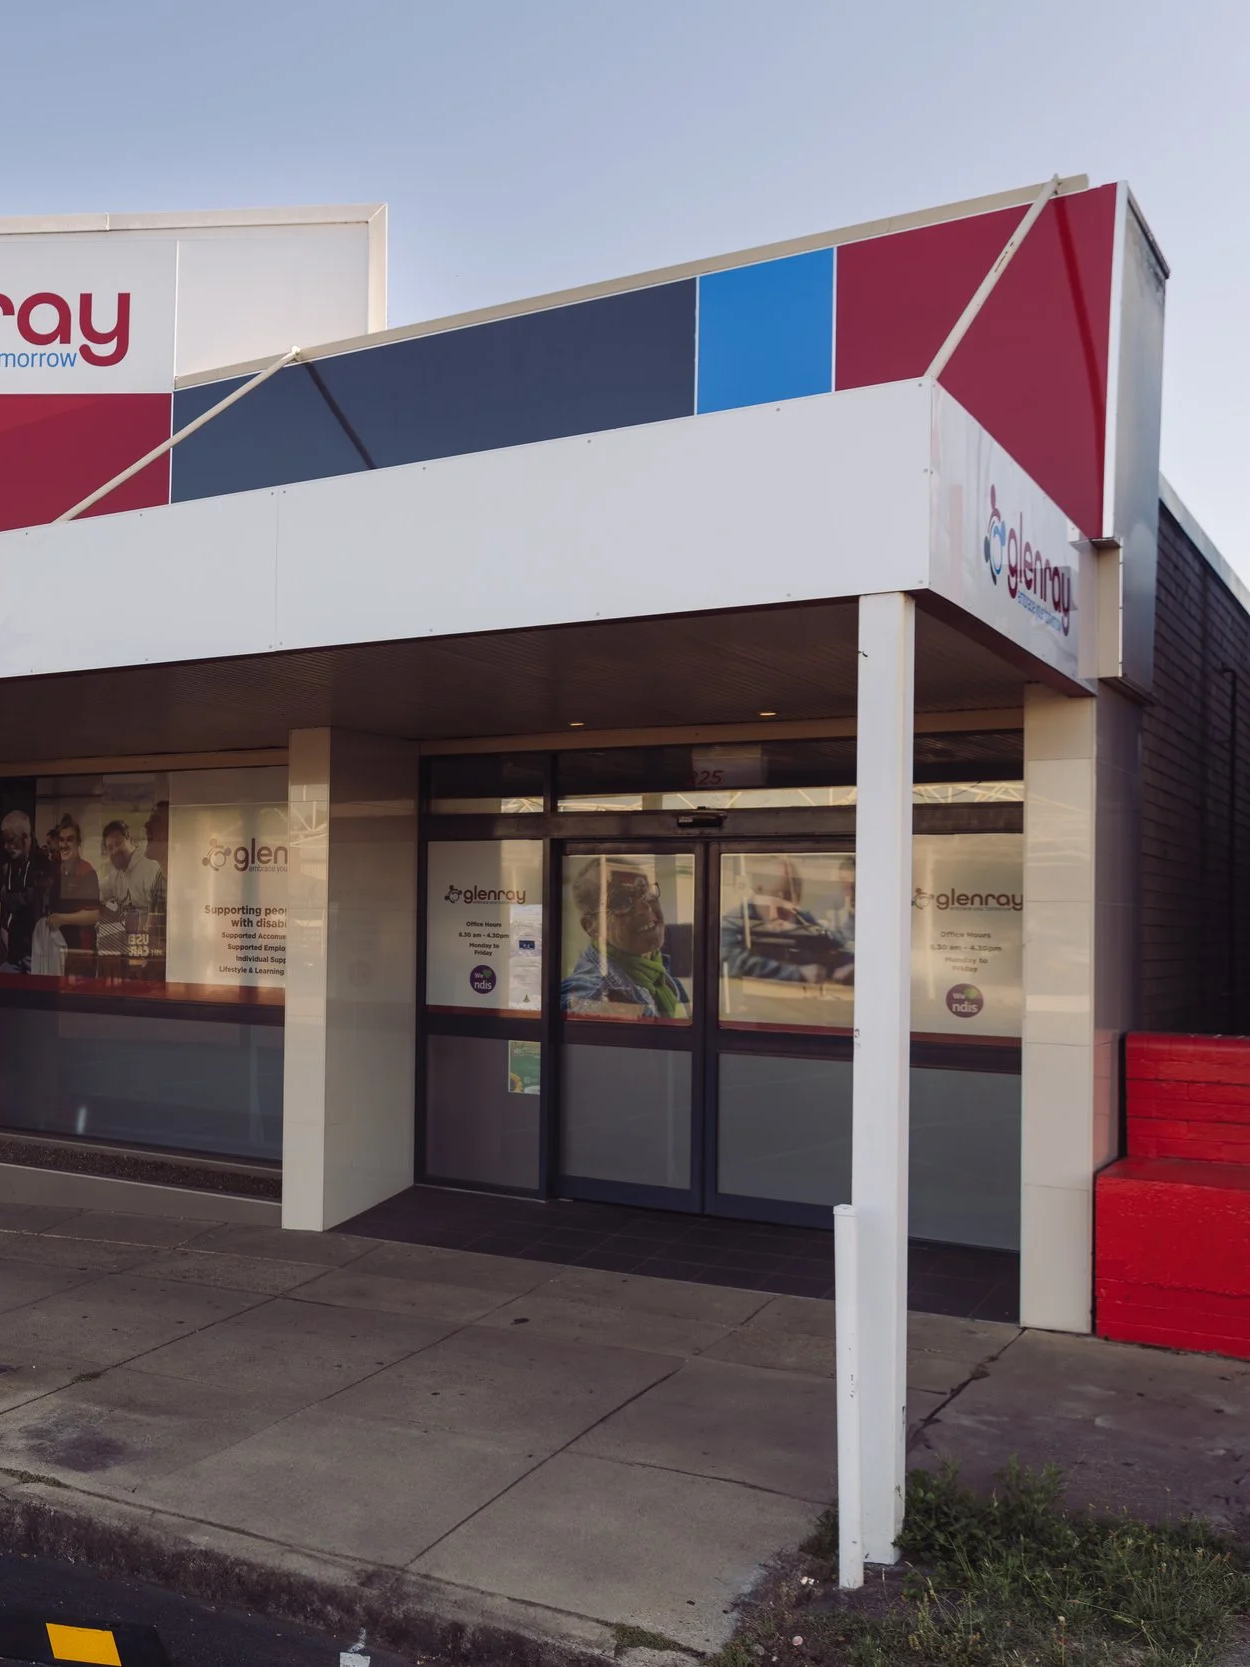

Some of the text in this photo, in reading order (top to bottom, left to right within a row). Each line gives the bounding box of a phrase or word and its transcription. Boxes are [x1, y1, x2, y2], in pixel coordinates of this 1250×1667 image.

[1007, 511, 1071, 637] glenray
[233, 837, 288, 872] glen
[249, 865, 288, 874] embrace you
[463, 885, 526, 905] glenray
[936, 888, 1023, 911] glenray
[204, 905, 262, 917] Supporting
[231, 917, 253, 928] with
[221, 932, 257, 940] Supported
[966, 931, 991, 939] Hours
[227, 943, 262, 951] Supported
[236, 955, 269, 963] Individual
[219, 966, 248, 974] Lifestyle
[255, 967, 285, 976] Learning
[474, 980, 492, 989] ndis
[952, 1001, 979, 1012] ndis
